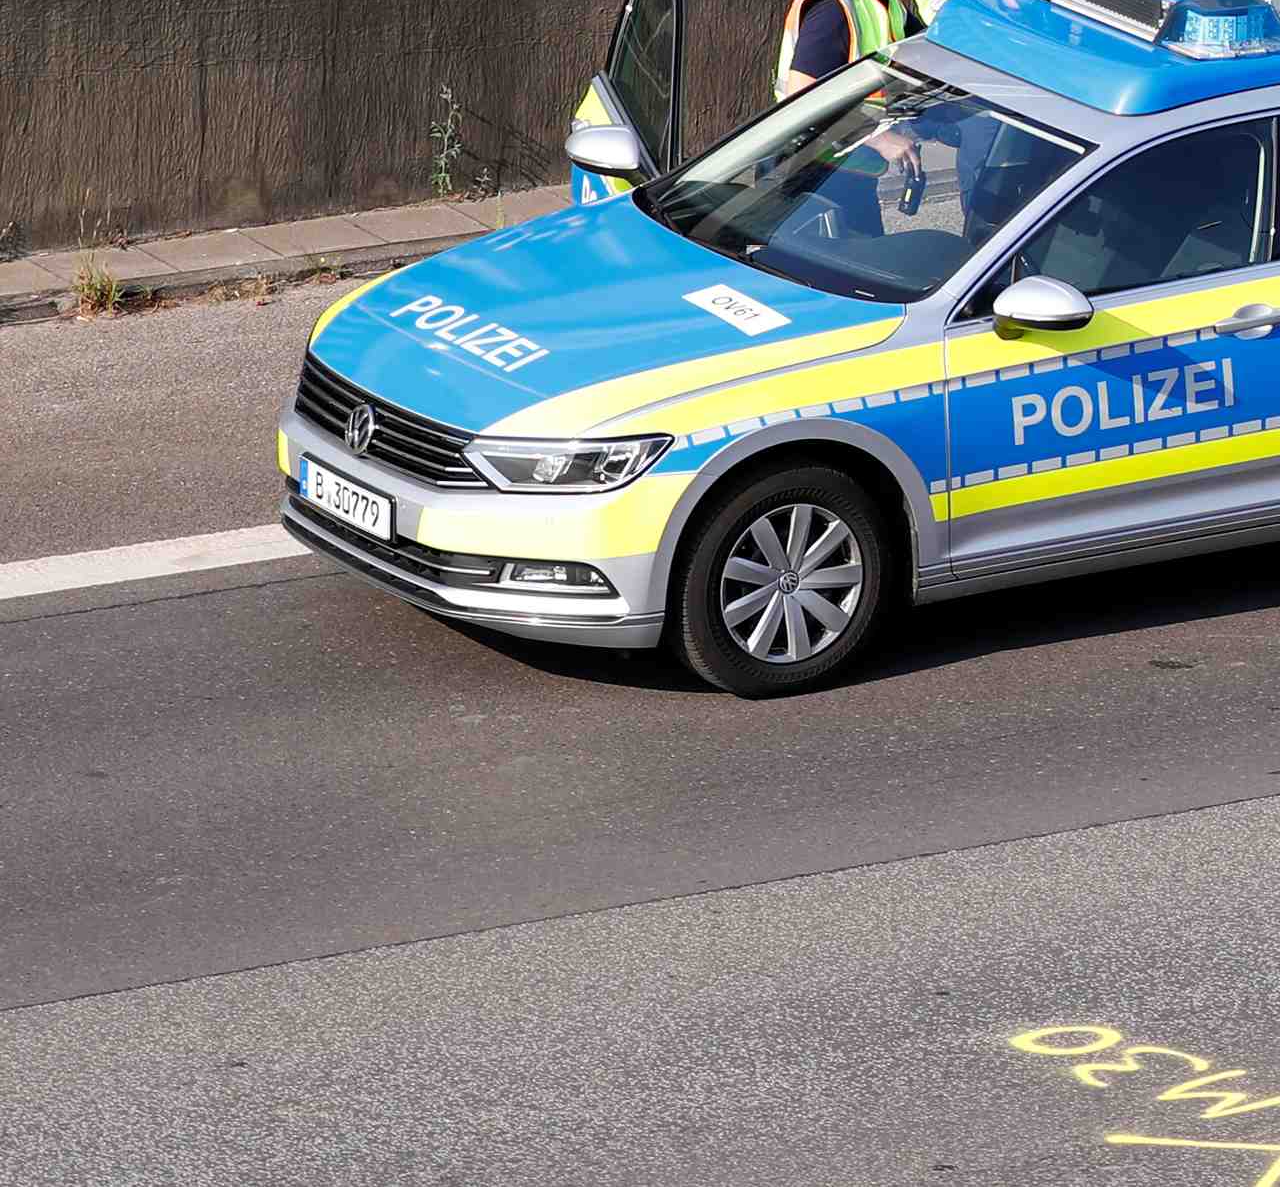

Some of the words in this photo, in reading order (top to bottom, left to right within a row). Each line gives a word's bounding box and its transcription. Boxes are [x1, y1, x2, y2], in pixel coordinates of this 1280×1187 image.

[389, 295, 550, 373] POLIZEI
[712, 296, 761, 321] OV61
[1011, 357, 1234, 445] POLIZEI
[316, 471, 323, 499] B
[333, 481, 380, 527] 30779
